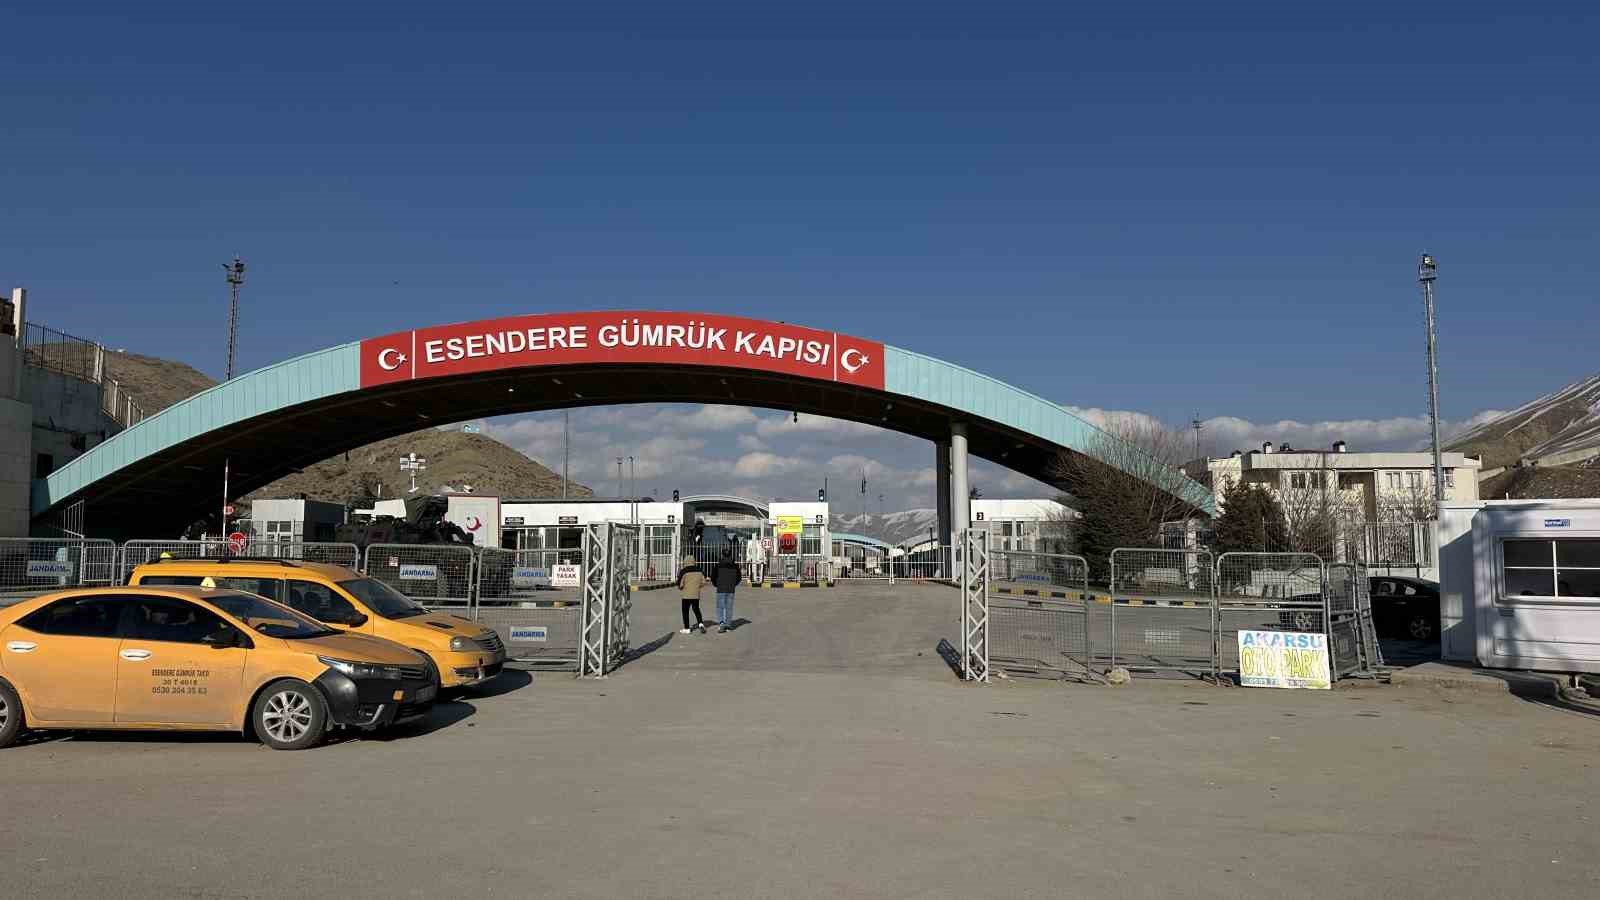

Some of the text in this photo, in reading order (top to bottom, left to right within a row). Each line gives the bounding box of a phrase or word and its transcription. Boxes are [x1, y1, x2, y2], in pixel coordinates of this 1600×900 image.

[425, 318, 830, 366] ESENDERE GÜMRÜK KAPISI
[401, 569, 435, 577] JANDARMA
[511, 630, 545, 638] JANDARMA
[1243, 632, 1323, 648] AKARSU
[1242, 646, 1328, 680] OTO PARK
